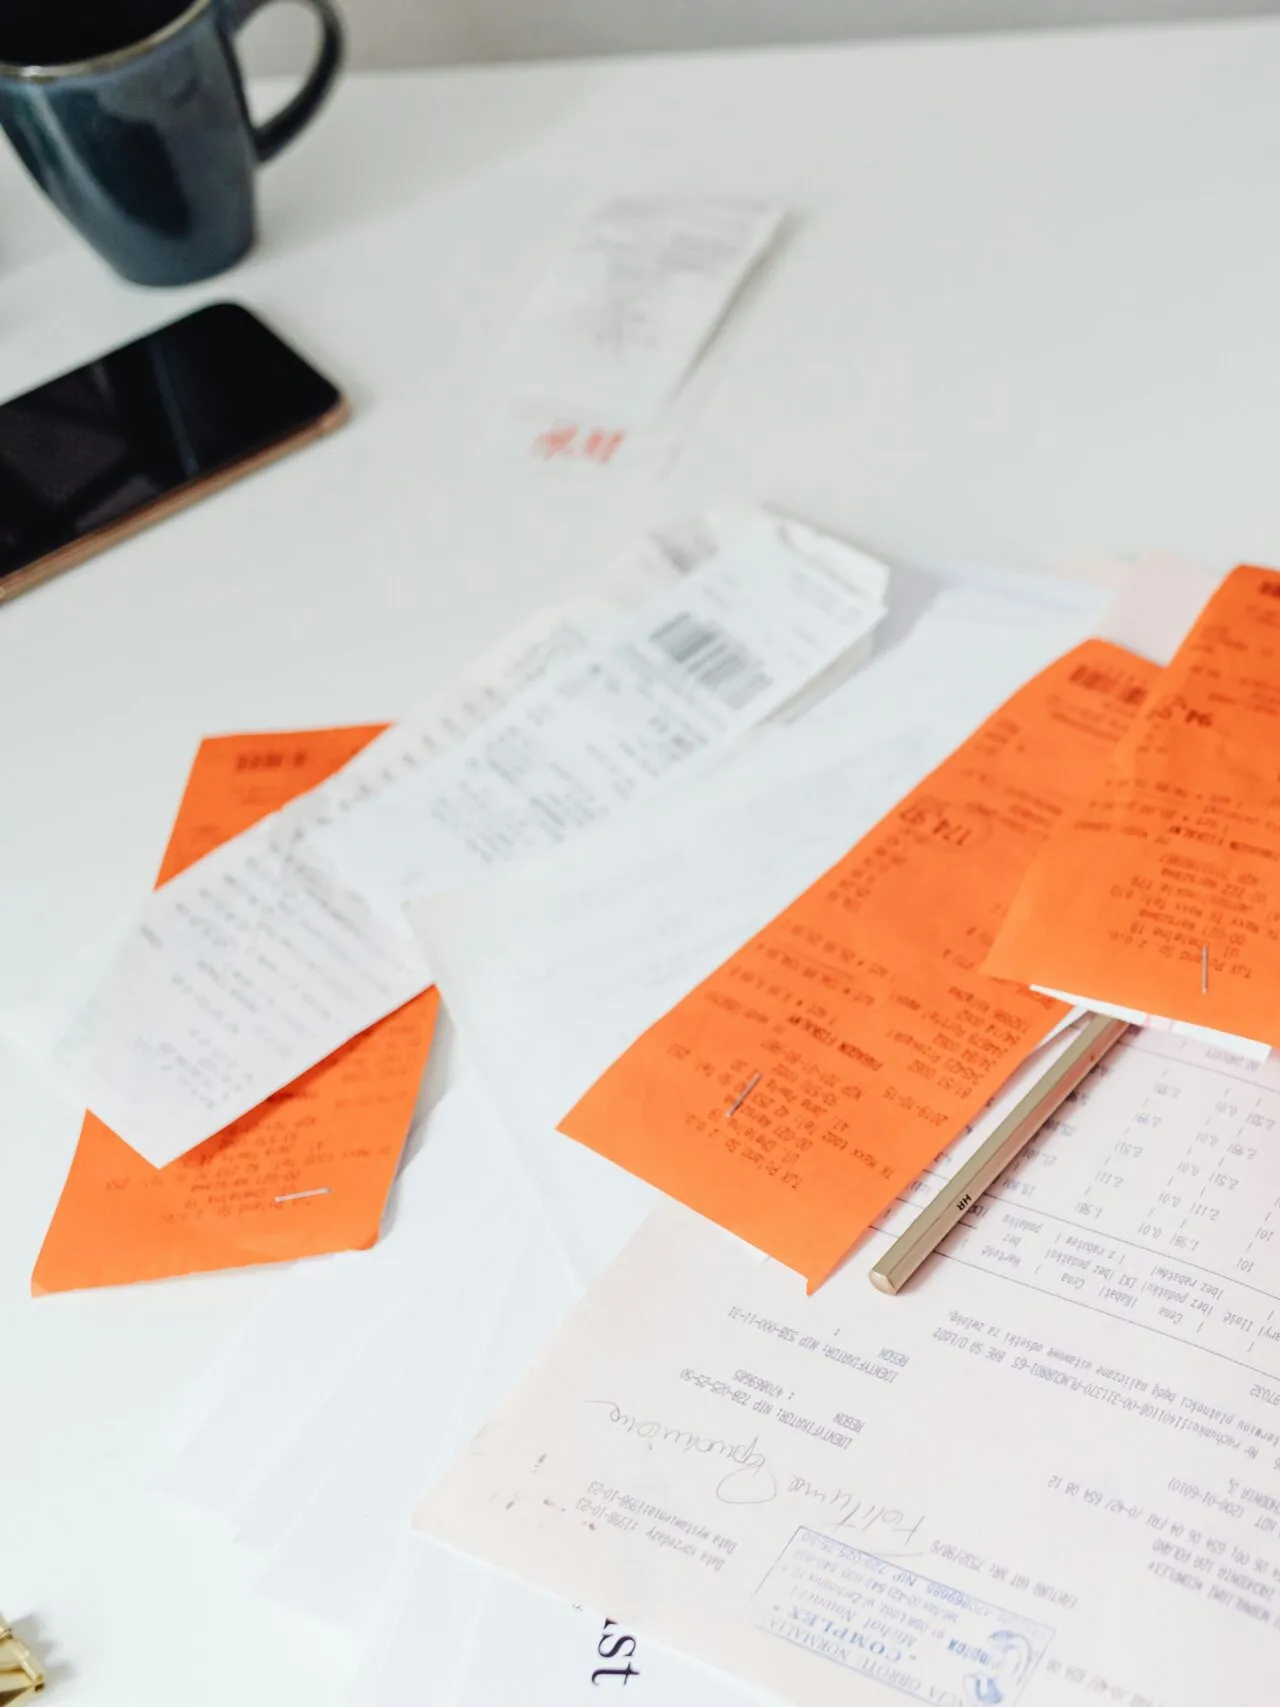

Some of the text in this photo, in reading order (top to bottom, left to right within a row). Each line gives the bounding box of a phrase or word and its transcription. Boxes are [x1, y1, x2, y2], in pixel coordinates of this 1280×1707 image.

[883, 1086, 948, 1126] 2019-10-15
[1003, 1234, 1021, 1247] bez
[1049, 1250, 1112, 1279] bez podatku
[1061, 1273, 1085, 1290] Cena
[1146, 1283, 1211, 1315] bez podatku
[1201, 1283, 1220, 1300] bez
[1158, 1307, 1183, 1324] Cena
[987, 1327, 1000, 1337] za
[799, 1337, 819, 1350] NIP
[1005, 1332, 1044, 1352] odsetki
[823, 1344, 898, 1383] IDENTYFIKATOR:
[878, 1348, 909, 1367] REGON
[1096, 1367, 1148, 1391] naliczane
[753, 1400, 773, 1414] NIP
[777, 1408, 853, 1449] IDENTYFIKATOR:
[833, 1413, 864, 1433] REGON
[1245, 1447, 1258, 1459] Nr
[712, 1535, 737, 1554] Data
[700, 1552, 725, 1571] Data
